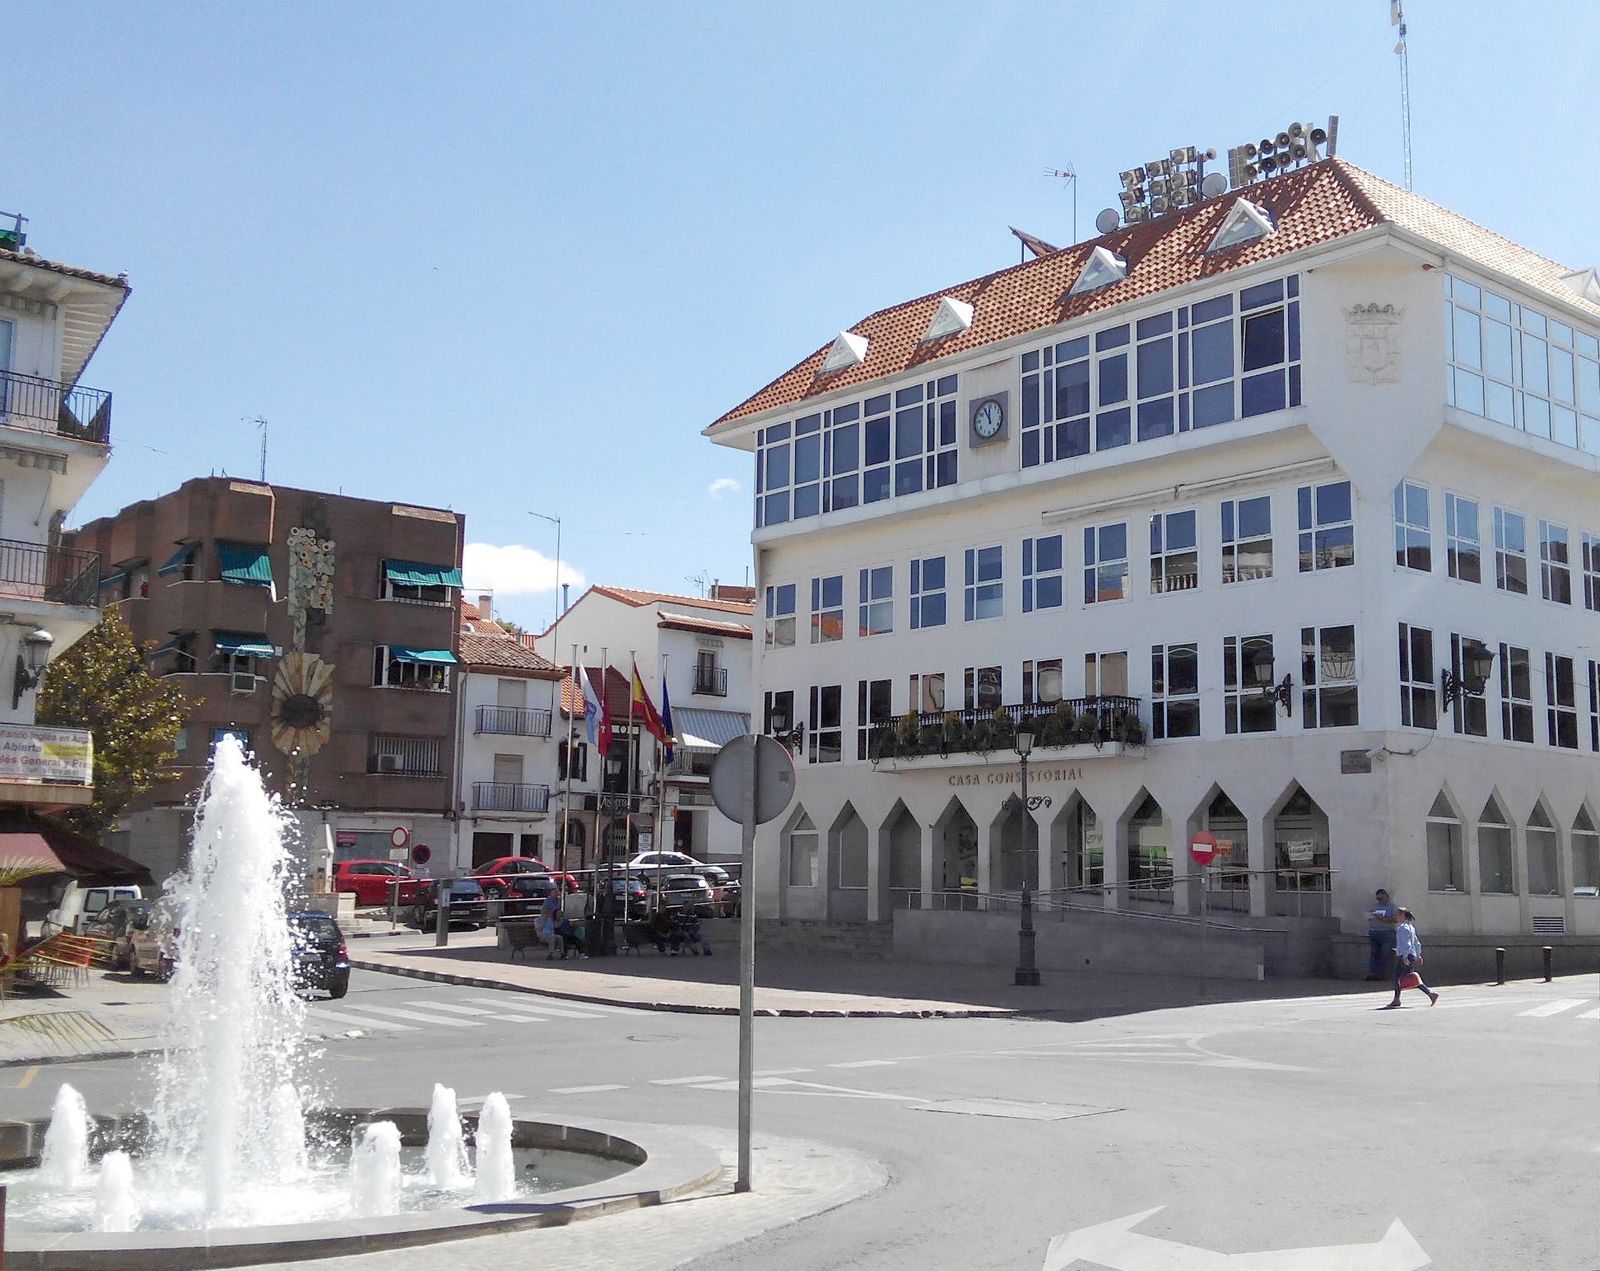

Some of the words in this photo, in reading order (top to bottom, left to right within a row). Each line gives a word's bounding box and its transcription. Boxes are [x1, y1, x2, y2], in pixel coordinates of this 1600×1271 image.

[20, 756, 61, 766] General
[948, 774, 980, 786] CASA
[987, 768, 1083, 785] CONSSTORIAL
